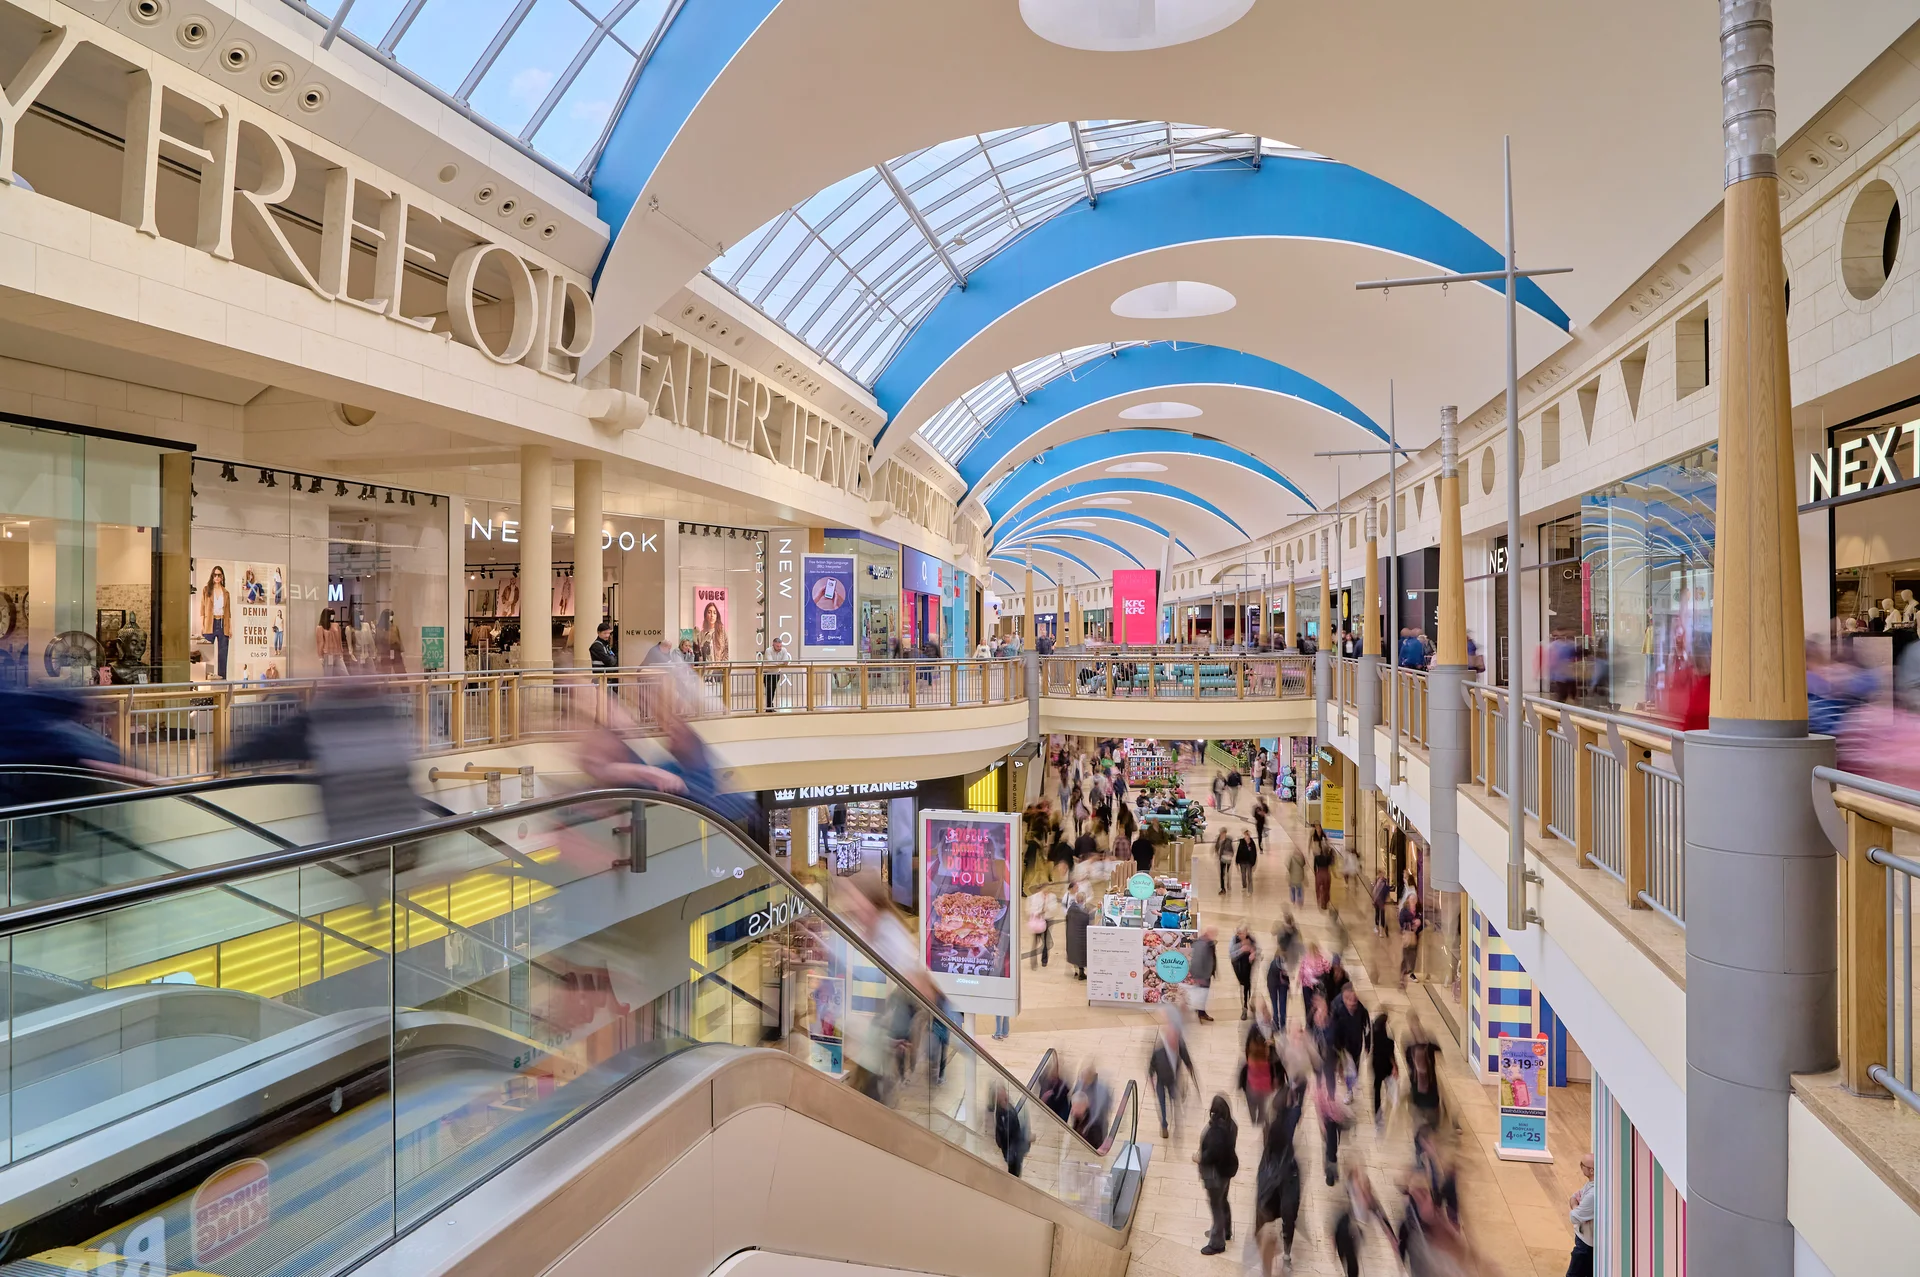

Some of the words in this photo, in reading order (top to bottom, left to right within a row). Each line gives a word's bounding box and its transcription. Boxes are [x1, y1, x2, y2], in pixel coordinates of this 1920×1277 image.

[637, 325, 778, 464] FATHER
[1810, 418, 1920, 503] NEXT
[601, 531, 657, 552] OOK
[779, 538, 792, 599] NEW
[698, 590, 725, 601] VIBES
[1124, 600, 1146, 608] KFC
[242, 607, 268, 617] DENIM
[1124, 607, 1146, 615] KFC
[243, 626, 268, 636] EVERY
[243, 635, 268, 645] THING
[779, 616, 792, 687] LOK
[800, 785, 834, 799] KING
[836, 784, 849, 793] OF
[850, 780, 918, 794] TRAINERS
[947, 856, 989, 872] DOUBLE
[951, 872, 985, 884] YOU
[1160, 958, 1185, 966] Stacked
[1503, 1058, 1511, 1069] 3
[1506, 1130, 1514, 1140] 4
